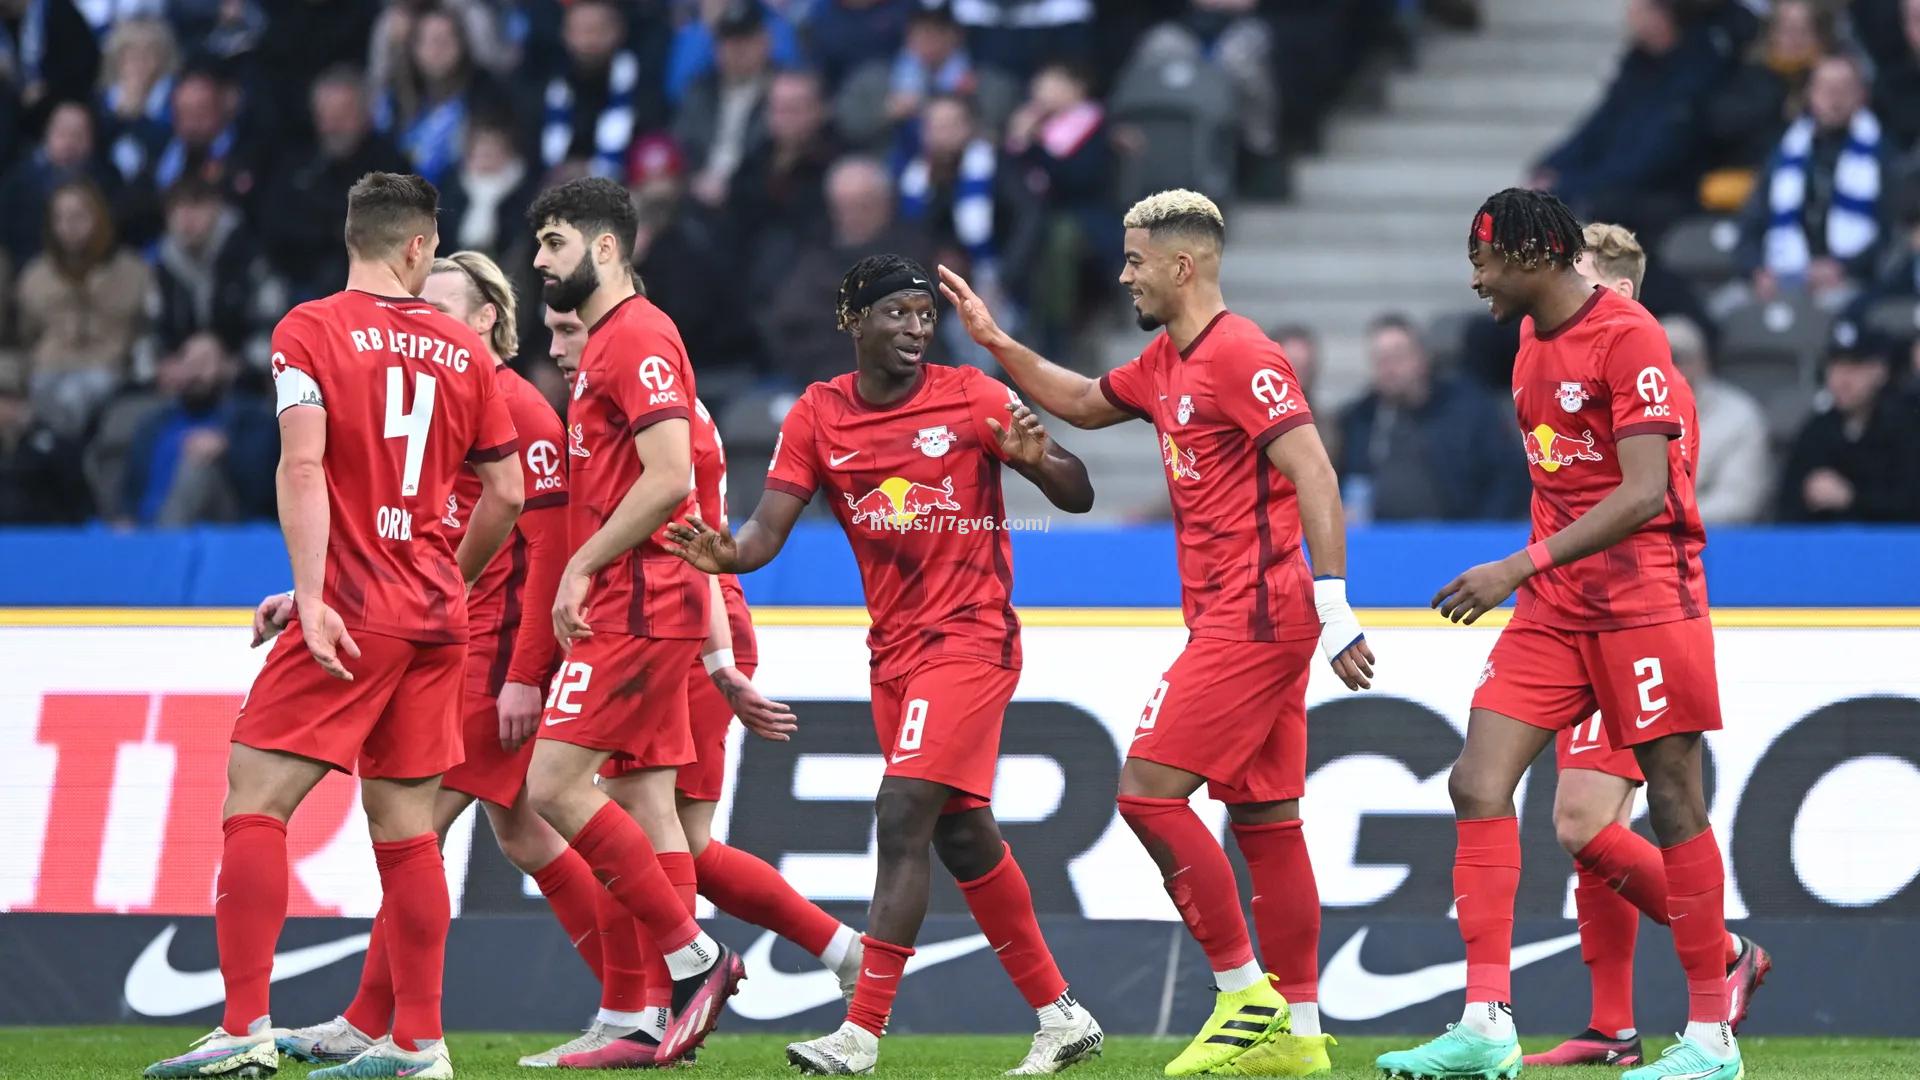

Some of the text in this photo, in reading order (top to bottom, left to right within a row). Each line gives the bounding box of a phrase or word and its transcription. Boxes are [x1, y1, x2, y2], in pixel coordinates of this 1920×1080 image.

[351, 327, 470, 373] RB LEIPZIG
[649, 391, 678, 405] AOC
[1267, 399, 1298, 420] AOC
[1643, 405, 1671, 417] AOC
[383, 366, 436, 497] 4
[535, 476, 561, 491] AOC
[376, 505, 412, 541] ORB
[1633, 657, 1668, 711] 2
[899, 698, 929, 750] 8
